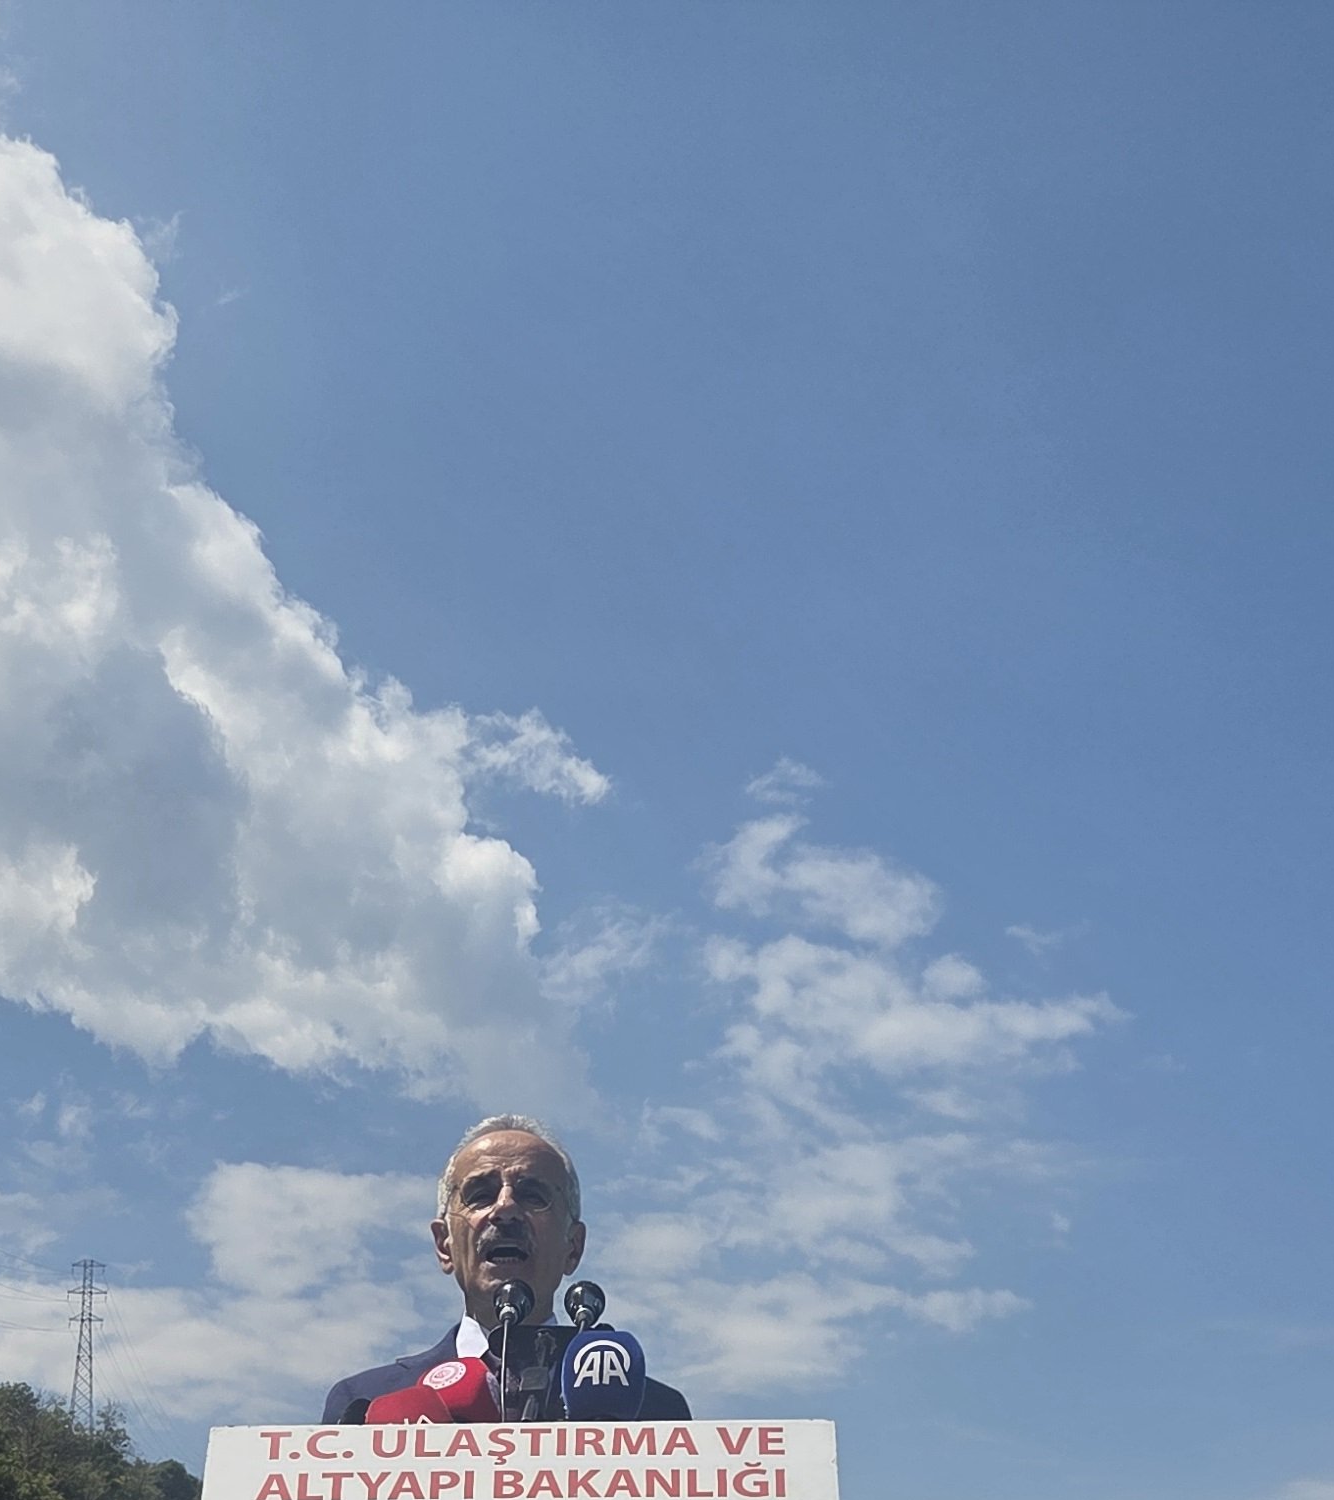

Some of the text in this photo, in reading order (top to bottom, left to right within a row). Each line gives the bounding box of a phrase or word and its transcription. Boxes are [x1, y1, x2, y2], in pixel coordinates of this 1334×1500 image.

[573, 1350, 631, 1388] AA
[260, 1427, 786, 1465] T.C. ULAŞTIRMA VE
[493, 1461, 786, 1499] BAKANLIĞI
